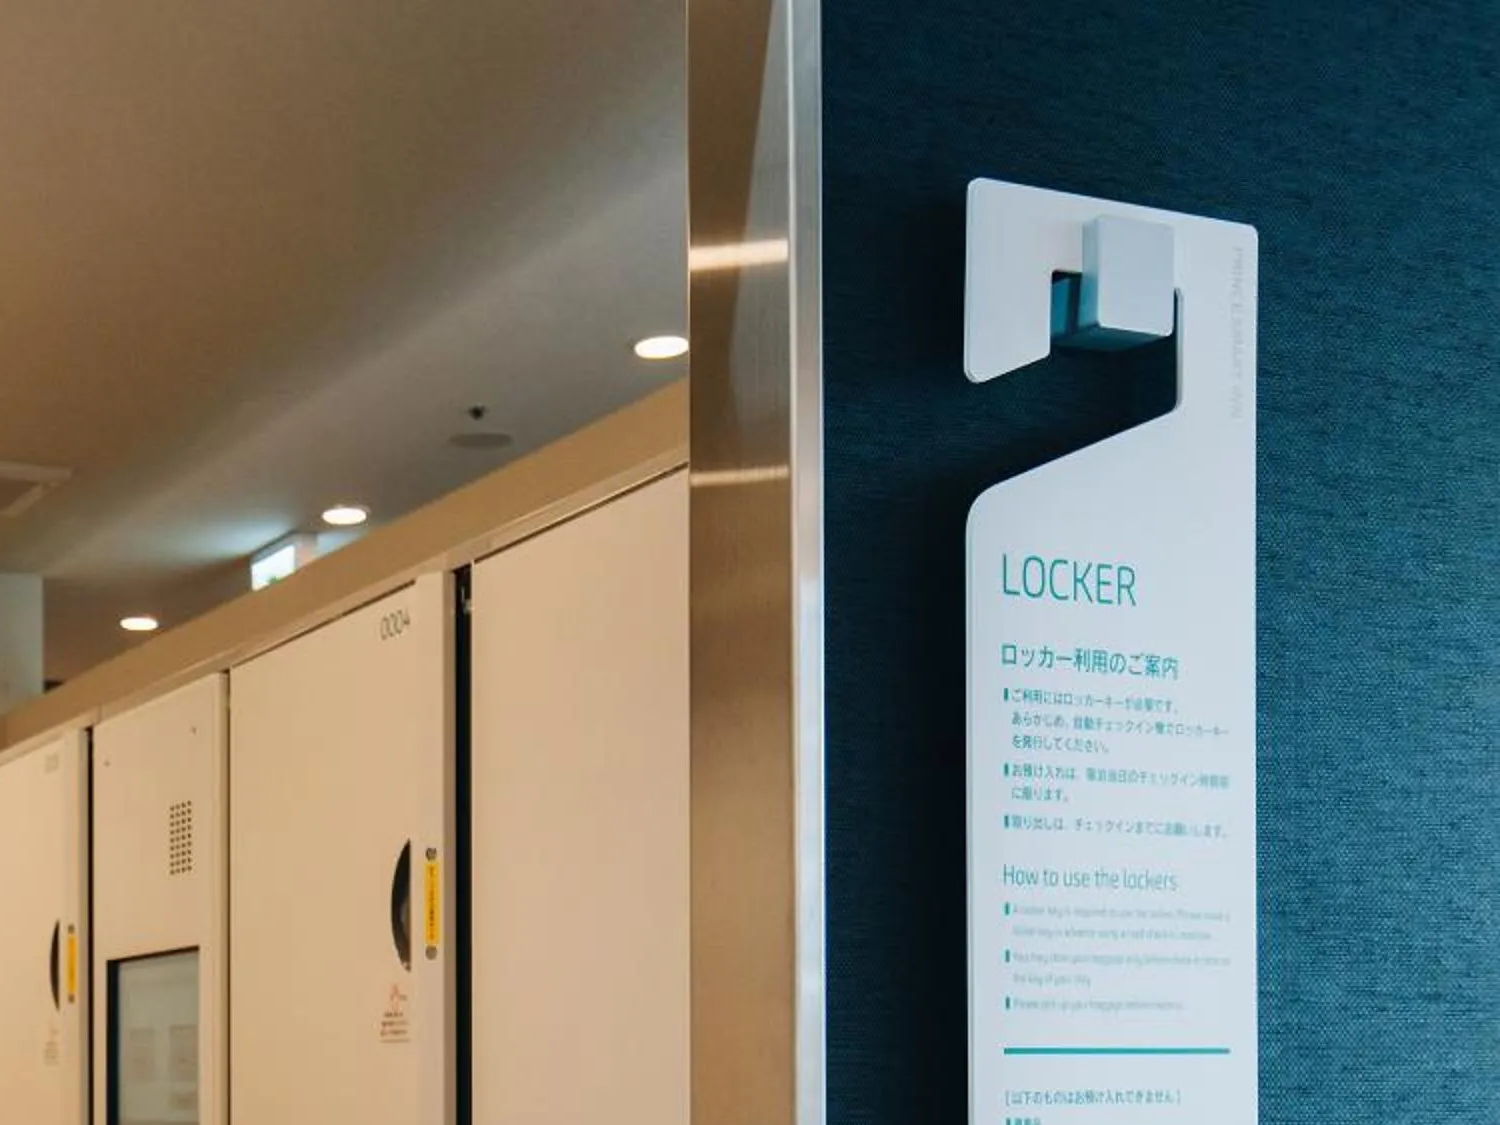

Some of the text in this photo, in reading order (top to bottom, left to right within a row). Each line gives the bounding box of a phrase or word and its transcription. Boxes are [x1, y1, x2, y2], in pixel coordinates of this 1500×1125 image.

[1002, 553, 1137, 606] LOCKER
[380, 607, 411, 640] 0004
[1001, 644, 1179, 680] ロッカー利用のご案内
[1003, 864, 1178, 891] How to use the lockers
